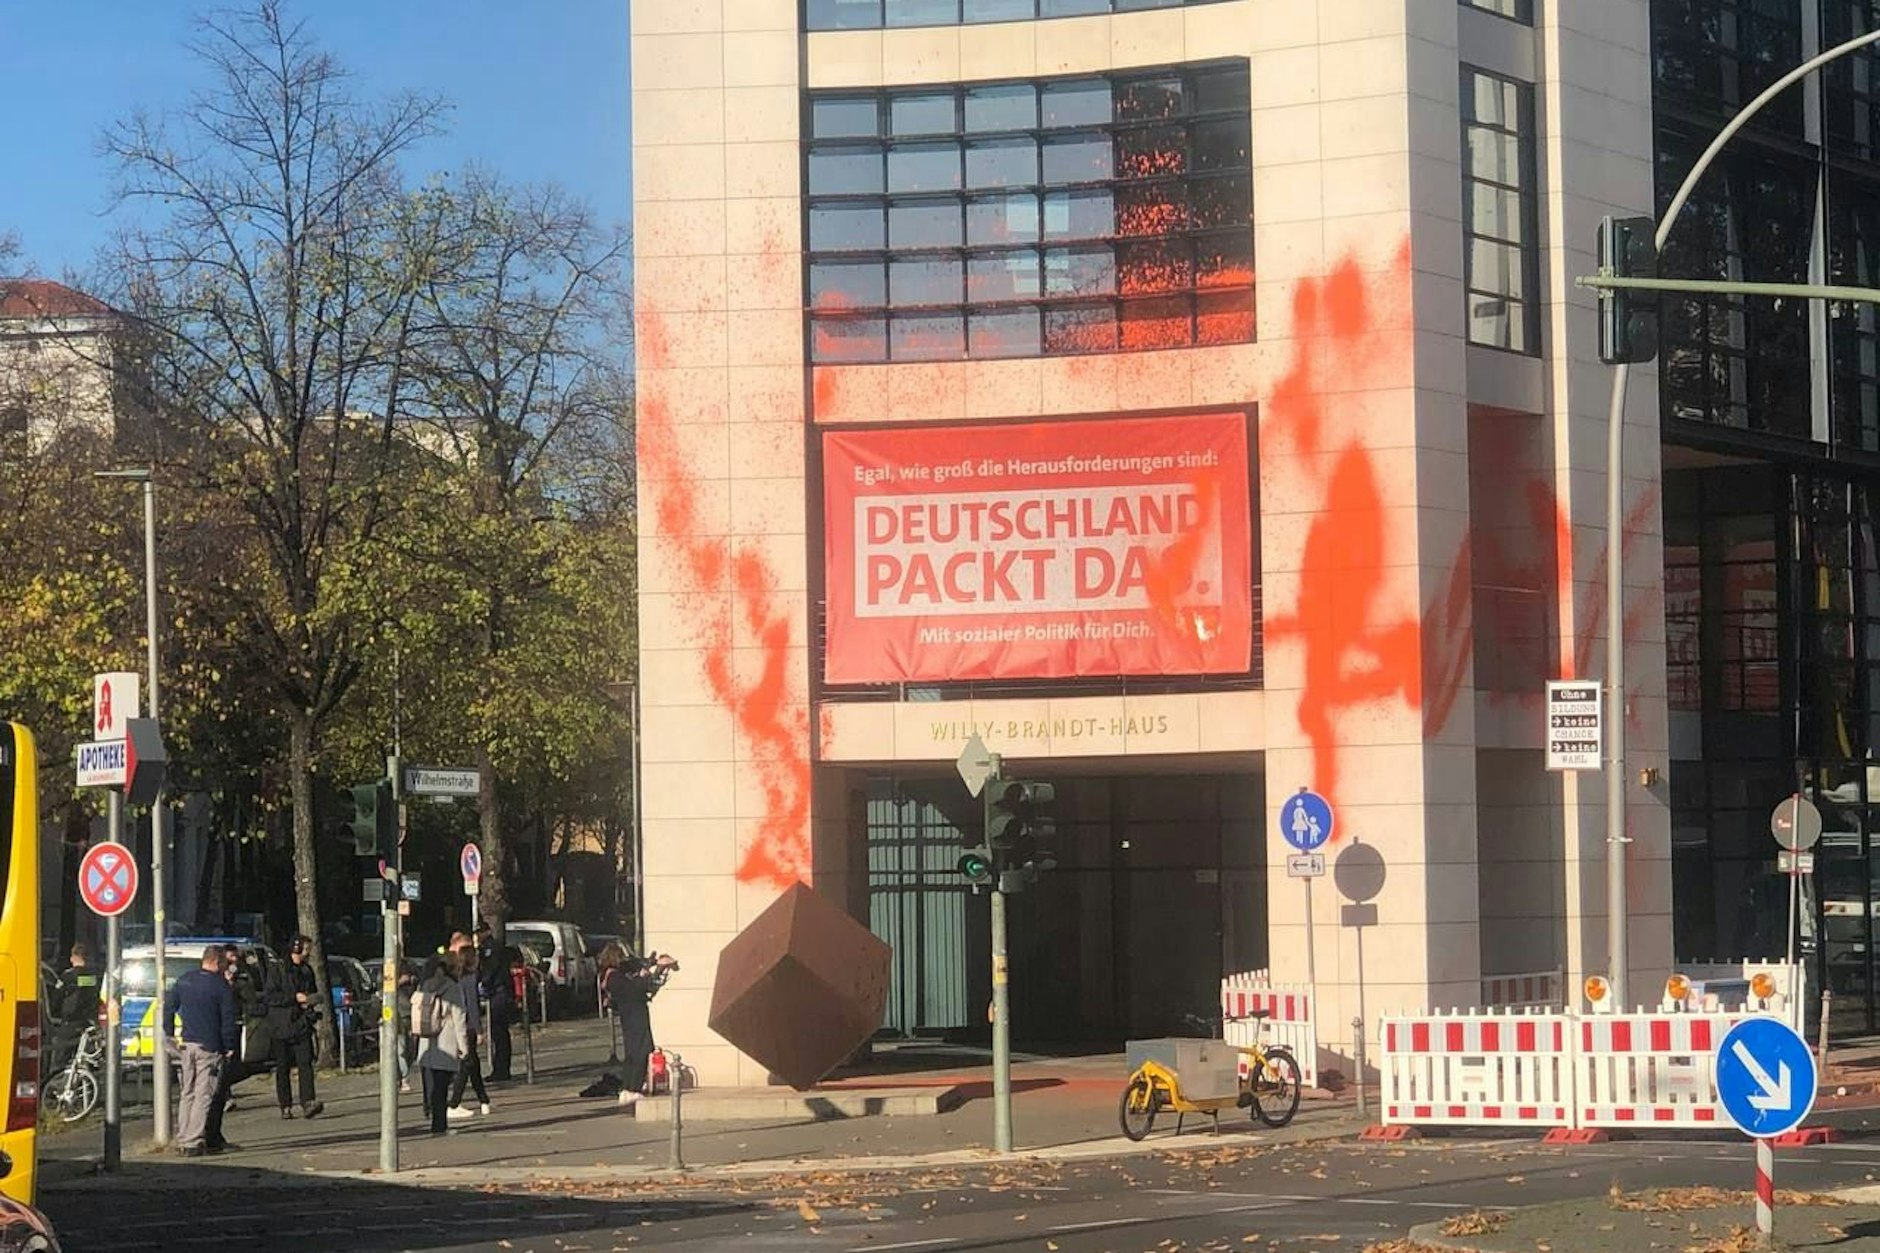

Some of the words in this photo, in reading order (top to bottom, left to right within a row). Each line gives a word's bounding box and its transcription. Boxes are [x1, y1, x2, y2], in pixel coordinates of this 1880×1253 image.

[854, 464, 896, 485] Egal,
[900, 463, 930, 480] wie
[934, 460, 973, 483] groß
[977, 459, 1004, 476] die
[1007, 454, 1173, 475] Herausforderungen
[1177, 448, 1218, 467] sind:
[867, 494, 1207, 545] DEUTSCHLAND
[867, 549, 1056, 605] PACKT
[919, 626, 950, 643] Mit
[954, 624, 1020, 642] sozialer
[1025, 623, 1079, 641] Politik
[1084, 621, 1110, 639] für
[1113, 620, 1155, 638] Dich.
[79, 744, 124, 771] APOTHEKE
[411, 772, 473, 790] Wilhelmstraße
